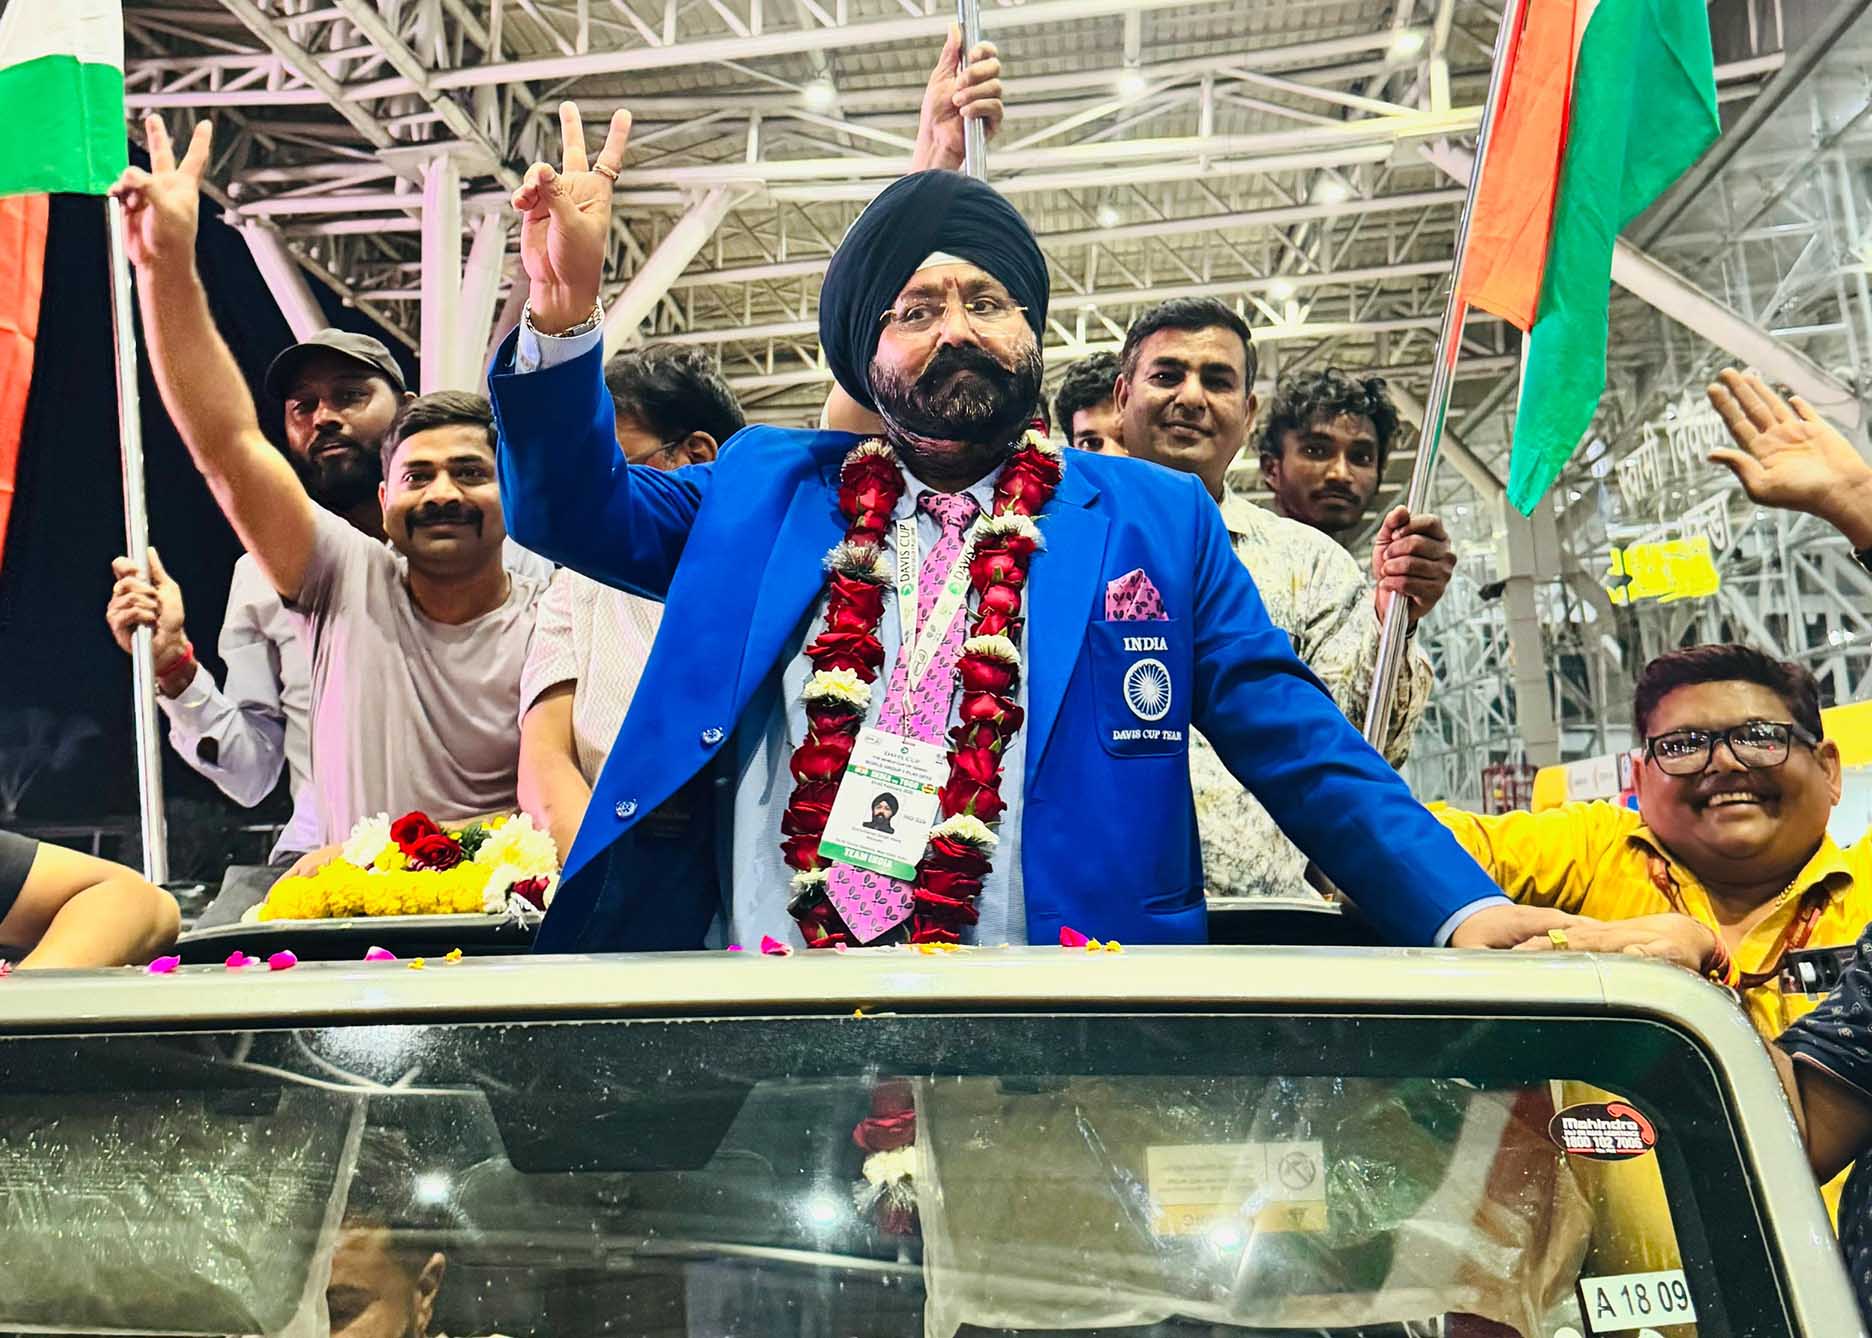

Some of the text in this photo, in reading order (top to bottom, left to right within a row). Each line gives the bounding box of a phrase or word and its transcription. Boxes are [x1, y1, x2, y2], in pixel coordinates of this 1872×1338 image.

[899, 524, 911, 583] DAVIS CUP
[1123, 637, 1168, 652] INDIA
[1113, 729, 1182, 741] DAVIS CUP TEAM
[844, 847, 867, 861] TEAM
[867, 854, 893, 867] INDIA
[1562, 1117, 1639, 1130] Mahindra
[1597, 1280, 1688, 1318] A 18 09
